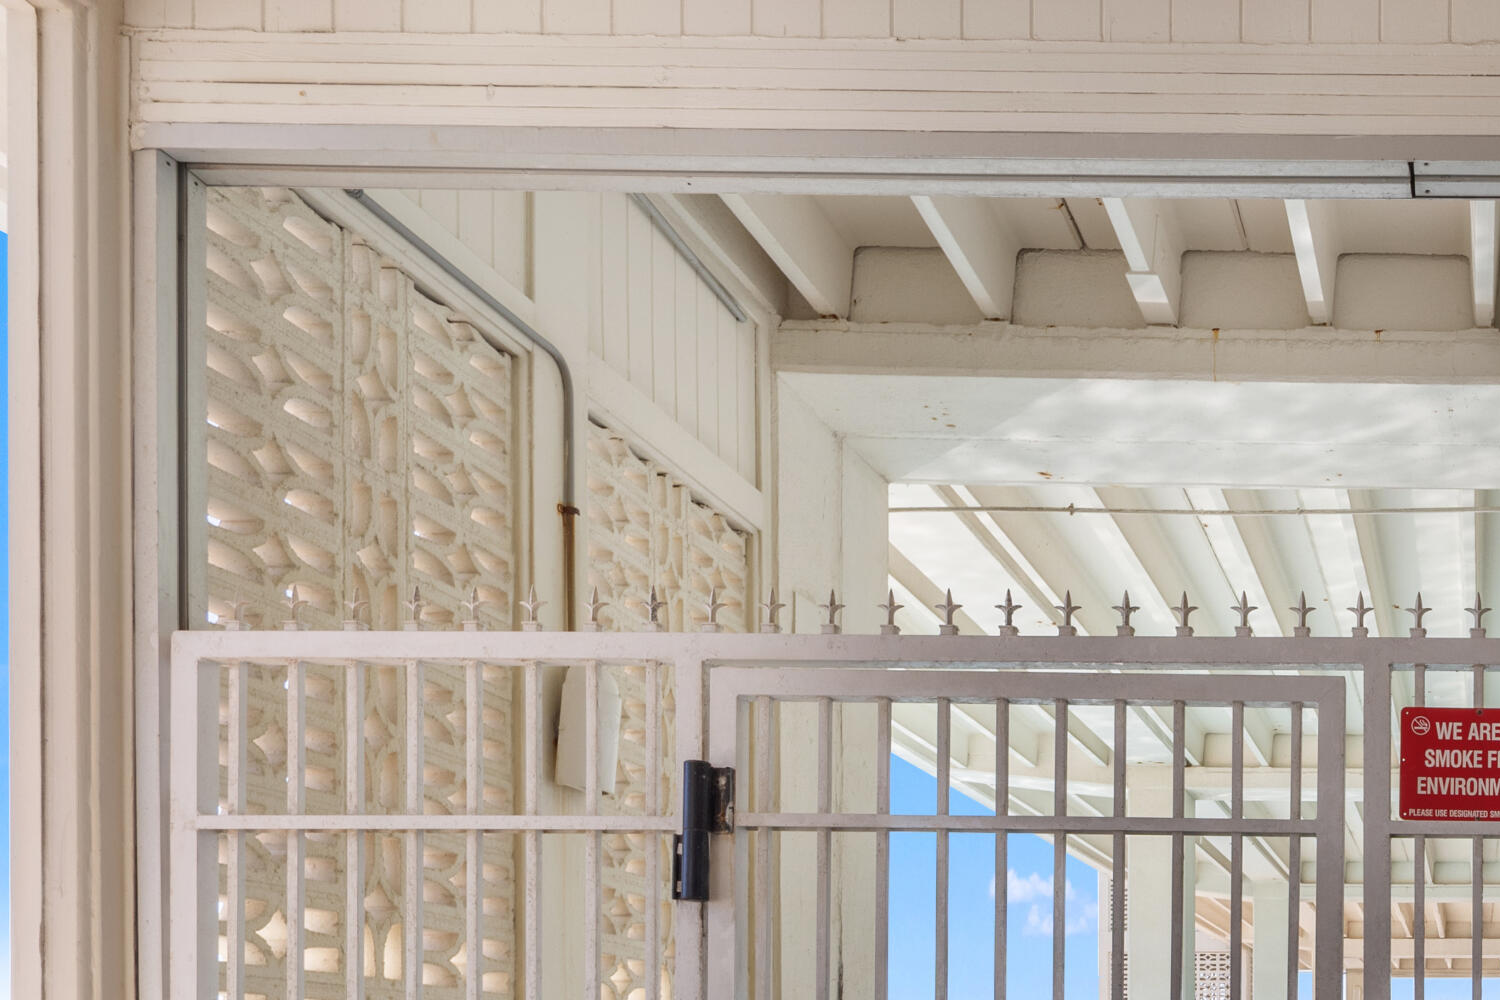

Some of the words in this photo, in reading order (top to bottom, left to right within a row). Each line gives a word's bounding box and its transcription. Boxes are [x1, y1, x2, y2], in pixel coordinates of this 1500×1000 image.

[1435, 721, 1463, 741] WE
[1467, 722, 1500, 741] ARE
[1424, 749, 1483, 769] SMOKE
[1409, 808, 1434, 817] PLEASE
[1435, 809, 1448, 818] USE
[1449, 809, 1488, 818] DESIGNATED
